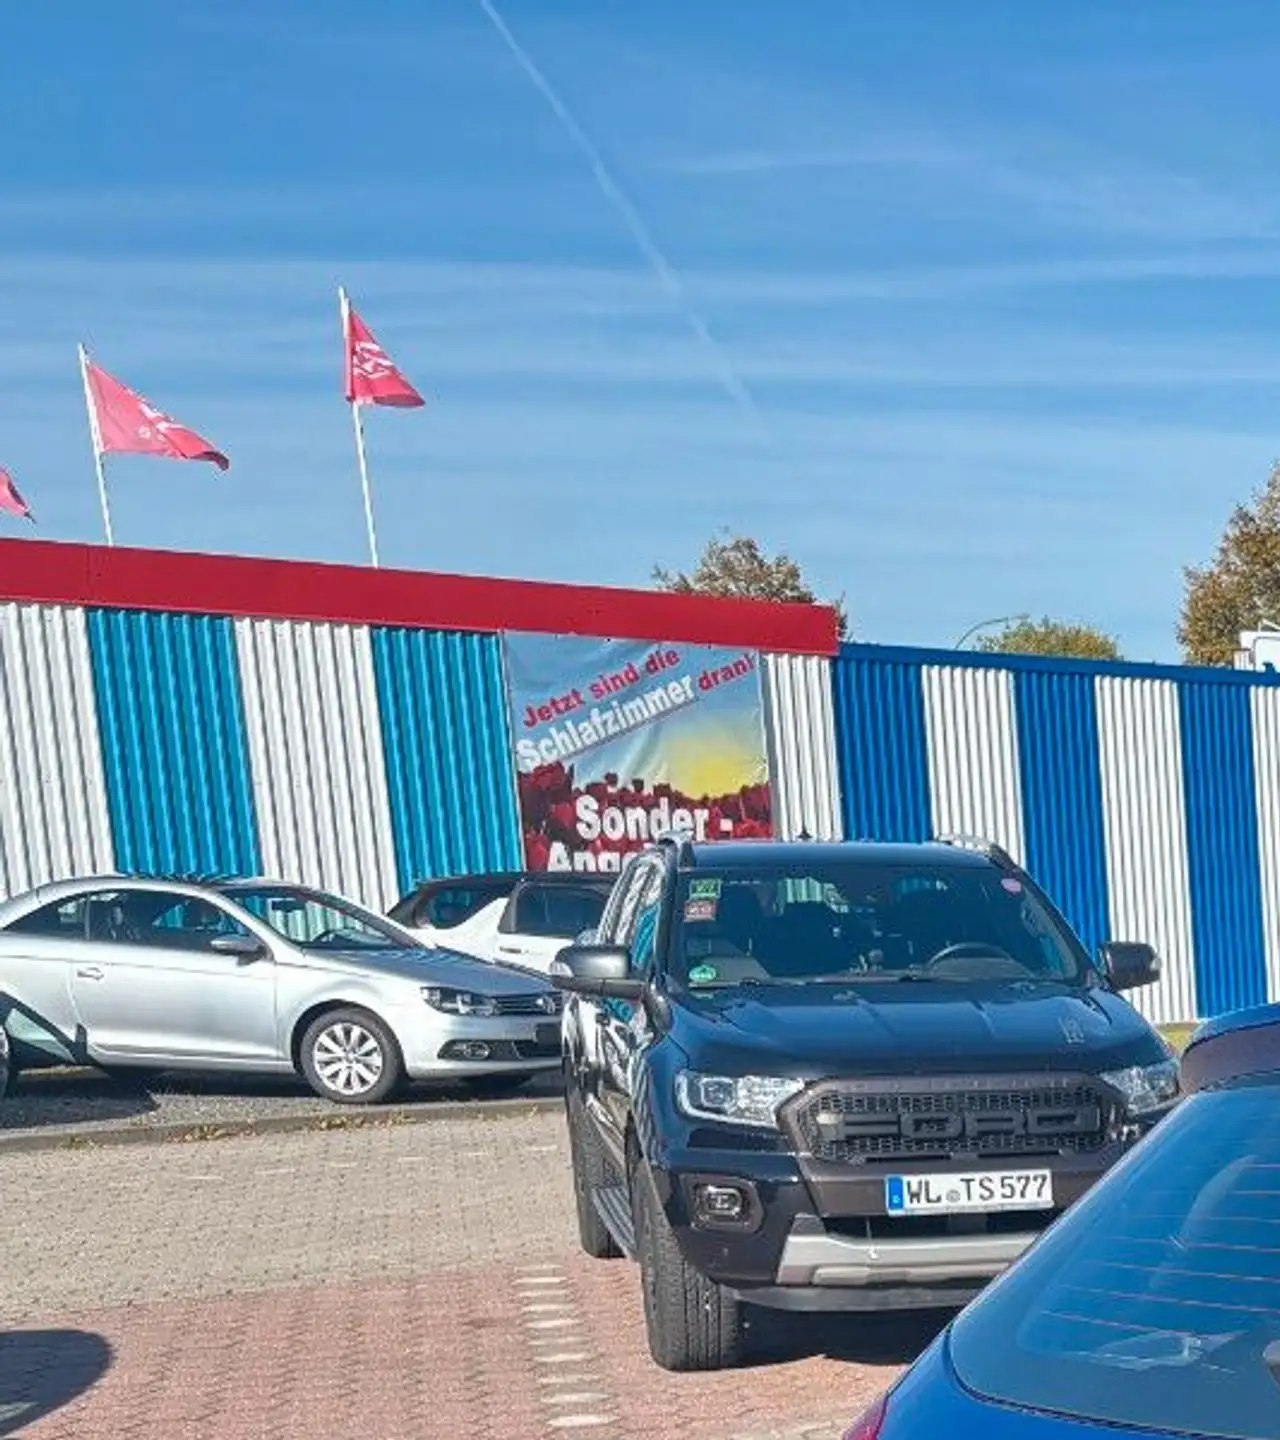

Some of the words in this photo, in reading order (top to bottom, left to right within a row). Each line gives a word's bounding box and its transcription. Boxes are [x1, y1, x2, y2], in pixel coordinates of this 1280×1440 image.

[516, 673, 696, 773] Schlafzimmer
[523, 687, 585, 728] Jetzt
[588, 662, 640, 702] sind
[645, 648, 681, 676] die
[906, 1178, 942, 1205] WL
